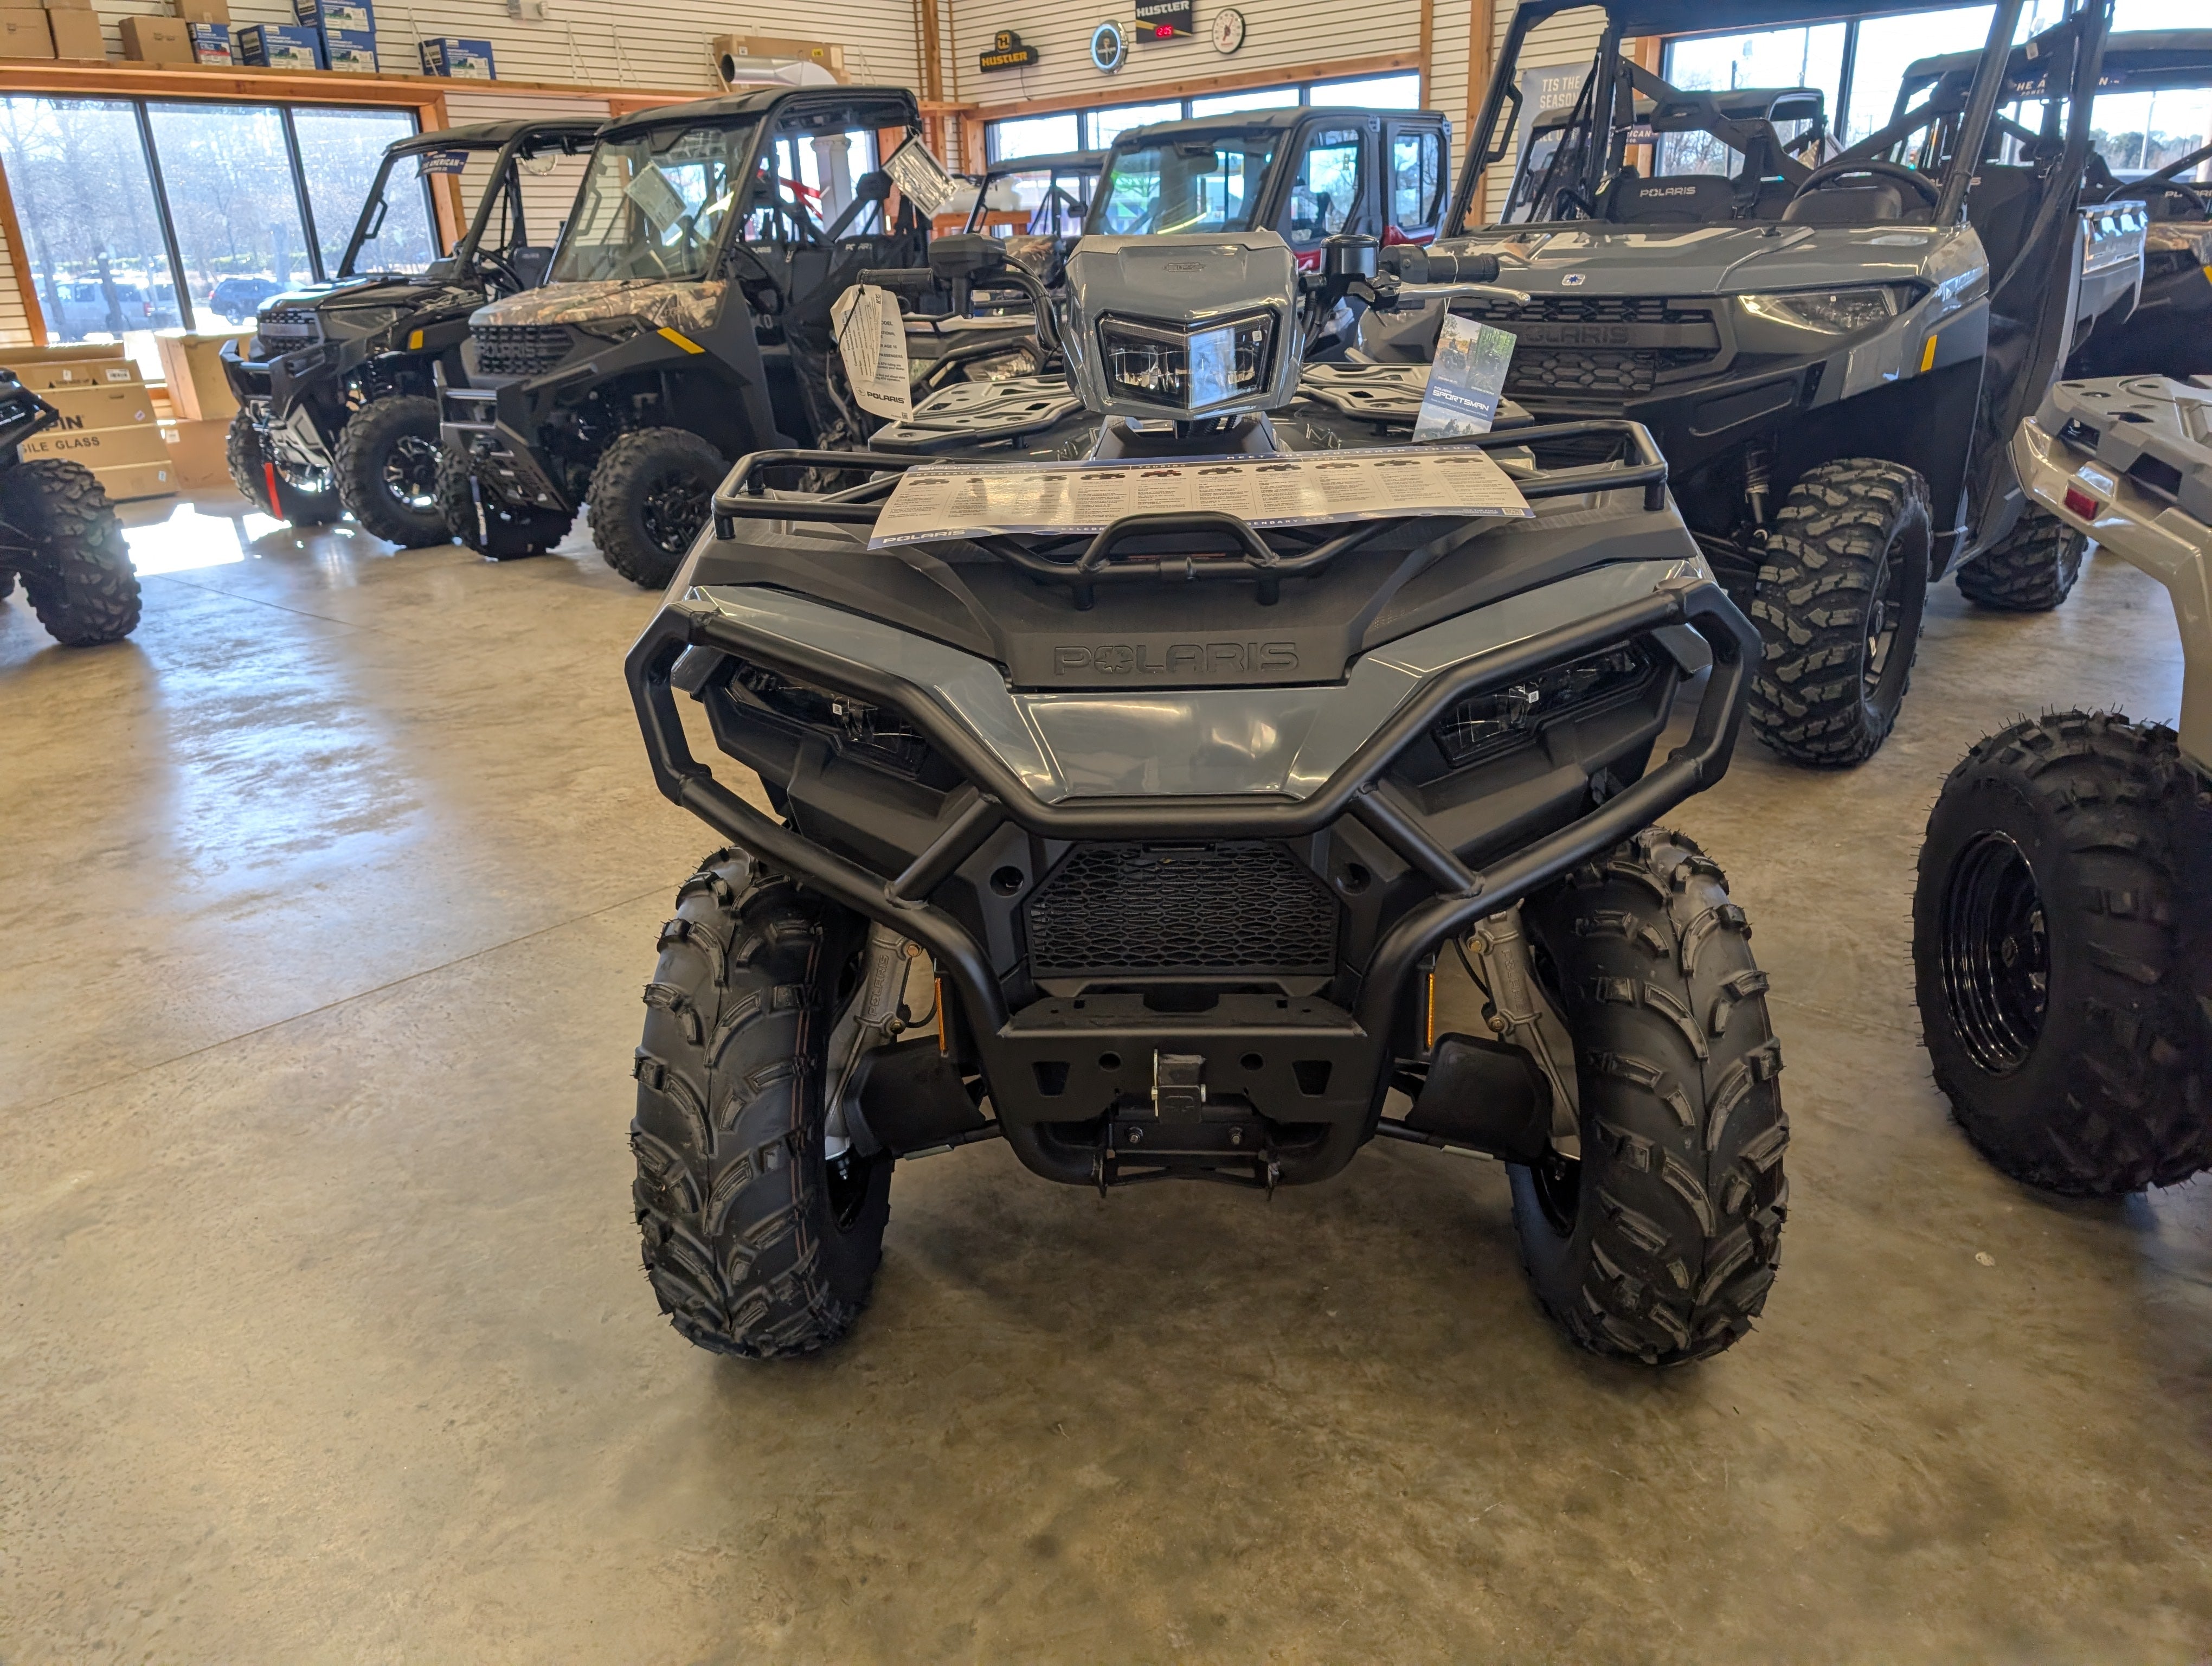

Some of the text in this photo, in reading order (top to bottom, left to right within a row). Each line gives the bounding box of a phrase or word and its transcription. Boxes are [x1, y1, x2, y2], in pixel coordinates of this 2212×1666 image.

[1136, 1, 1190, 17] HUSTLER
[981, 52, 1027, 66] HUSTLER
[1542, 76, 1581, 92] TIS THE
[1540, 92, 1580, 108] SEASON
[1639, 187, 1696, 197] POLARIS
[1525, 326, 1629, 344] OLARIS
[867, 391, 905, 404] POLARIS
[1432, 389, 1489, 412] SPORTSMAN
[55, 436, 100, 450] GLASS
[882, 529, 966, 543] POLARIS
[1054, 642, 1300, 676] POLARIS
